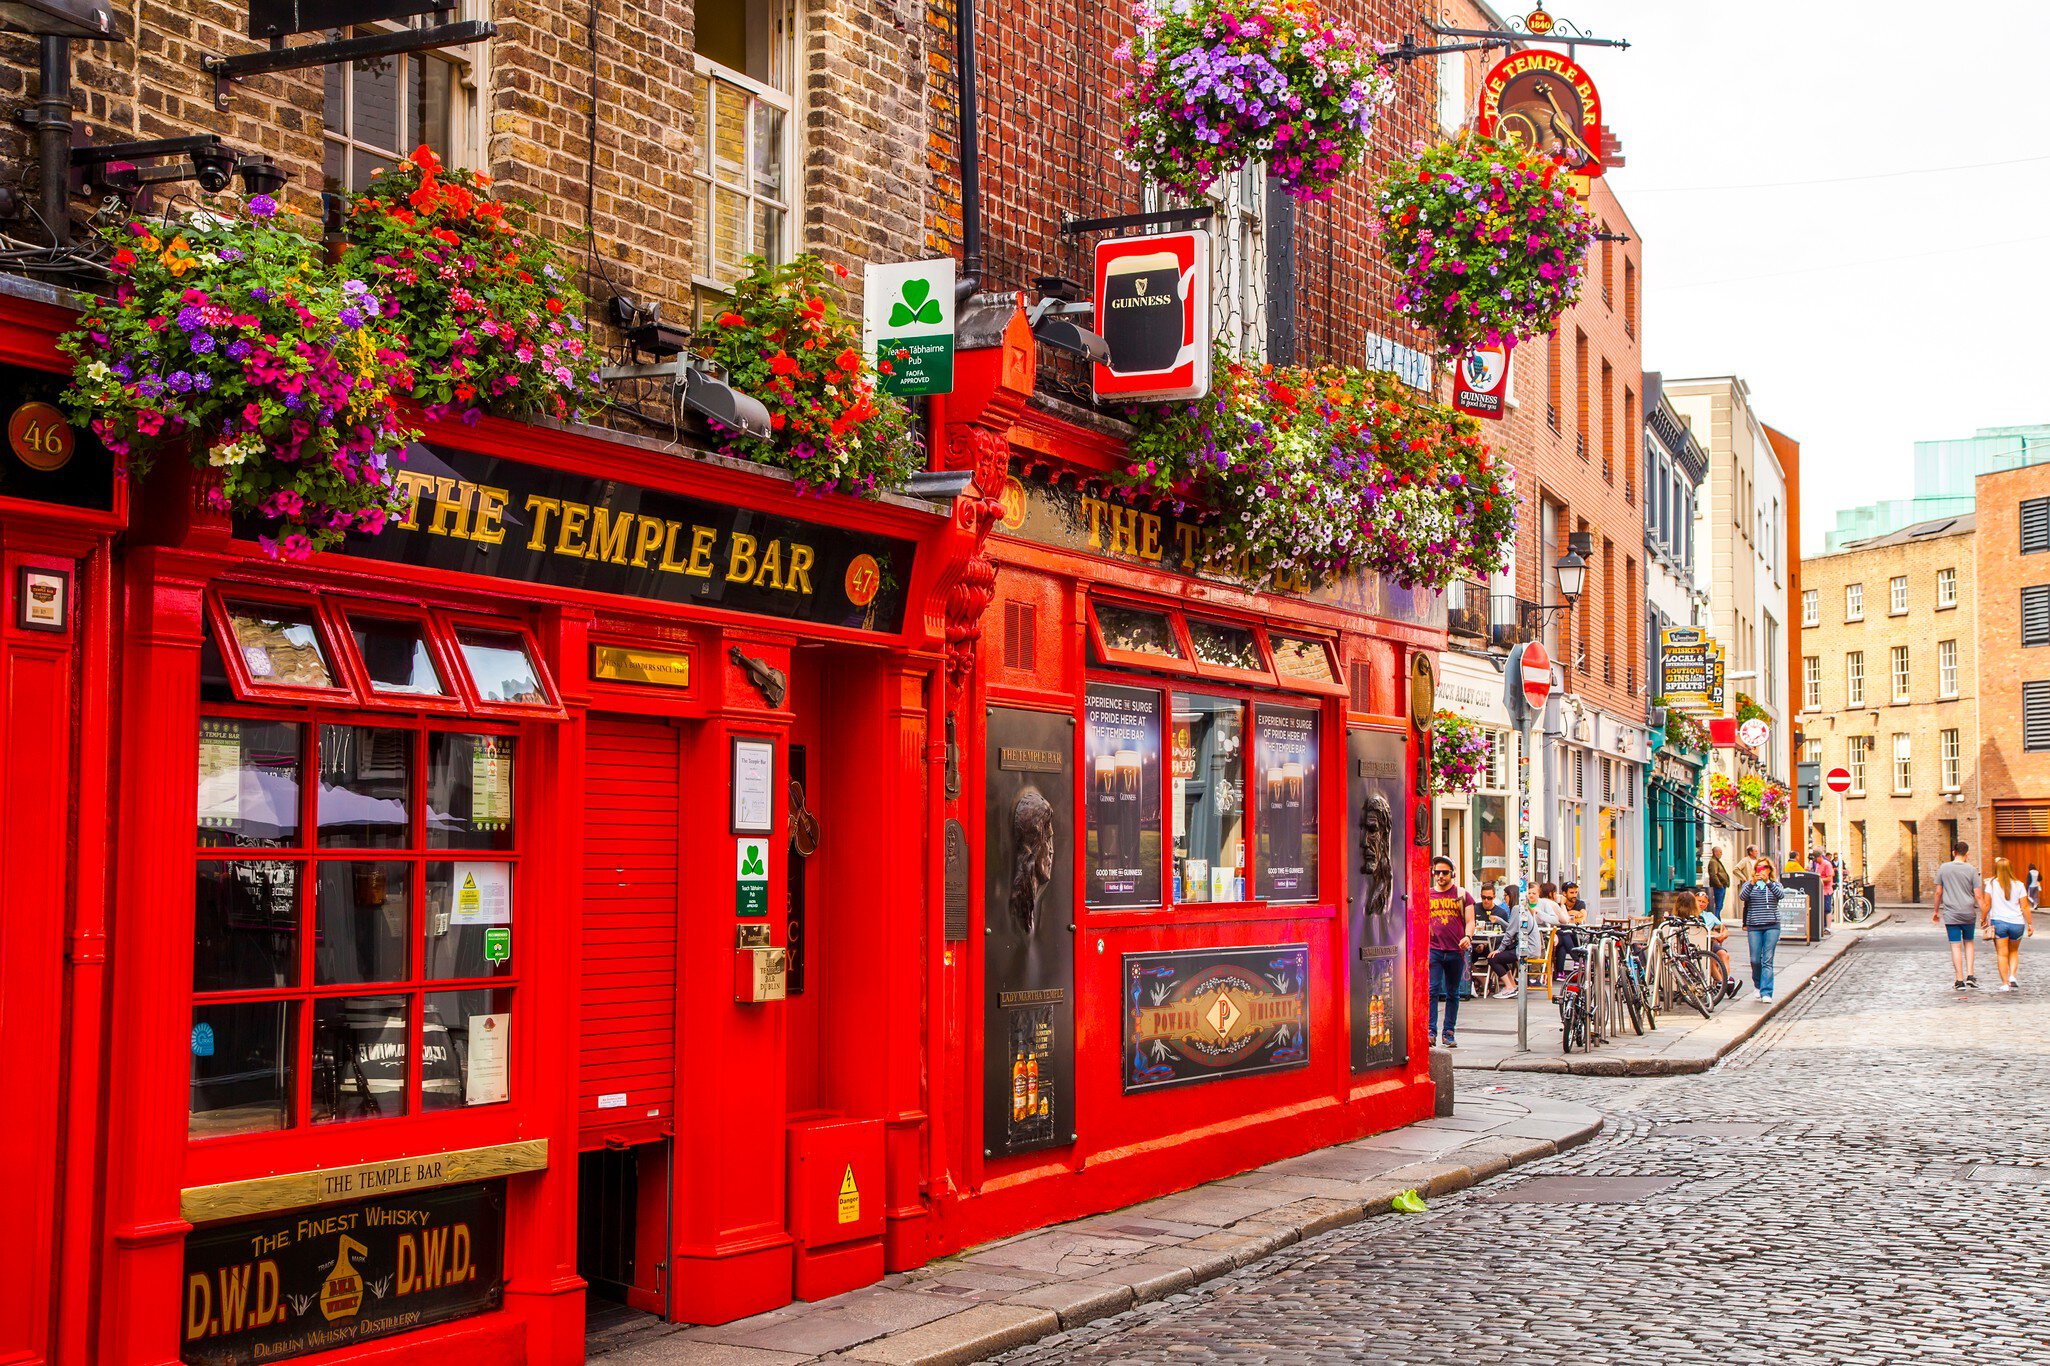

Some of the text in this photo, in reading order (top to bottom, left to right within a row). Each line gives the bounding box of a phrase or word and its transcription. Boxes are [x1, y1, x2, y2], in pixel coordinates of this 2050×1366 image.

[1530, 20, 1550, 29] 1840
[1484, 54, 1597, 126] THE TEMPLE BAR
[1111, 293, 1172, 309] GUINNESS
[908, 344, 944, 355] Tábhairne
[908, 356, 922, 365] Pub
[899, 376, 930, 385] APPROVED
[1460, 391, 1498, 404] GUINNESS
[1466, 400, 1478, 408] good
[23, 419, 62, 454] 46
[396, 468, 815, 595] THE TEMPLE BAR
[1082, 496, 1163, 561] THE
[851, 567, 874, 594] 47
[1665, 655, 1696, 663] LOCAL
[656, 665, 673, 673] SINCE
[1665, 674, 1689, 682] GINS
[1665, 682, 1705, 690] SPIRITS!
[1084, 695, 1122, 710] EXPERIENCE
[1132, 701, 1153, 713] SURGE
[1090, 711, 1146, 726] OF PRIDE HERE AT
[1258, 715, 1288, 727] EXPERIENCE
[1296, 719, 1312, 729] SURGE
[1092, 725, 1144, 740] THE TEMPLE BAR
[1264, 729, 1307, 741] OF PRIDE HERE AT
[1265, 742, 1306, 754] THE TEMPLE BAR
[1002, 749, 1062, 764] THE TEMPLE BAR
[1096, 868, 1108, 877] GOOD
[1109, 868, 1118, 877] TIME
[1123, 869, 1143, 877] GUINNESS
[765, 975, 776, 983] BAR
[1001, 988, 1063, 1003] LADY MARTHA TEMPLE
[1153, 999, 1293, 1034] POWERS P WHISKEY
[325, 1161, 442, 1194] THE TEMPLE BAR
[839, 1196, 858, 1204] Danger
[252, 1206, 431, 1257] THE FINEST WHISKY
[396, 1222, 477, 1297] D.W.D.
[187, 1258, 287, 1342] D.W.D.
[254, 1311, 421, 1359] DUBLIN WHISKY DISTILLERY
